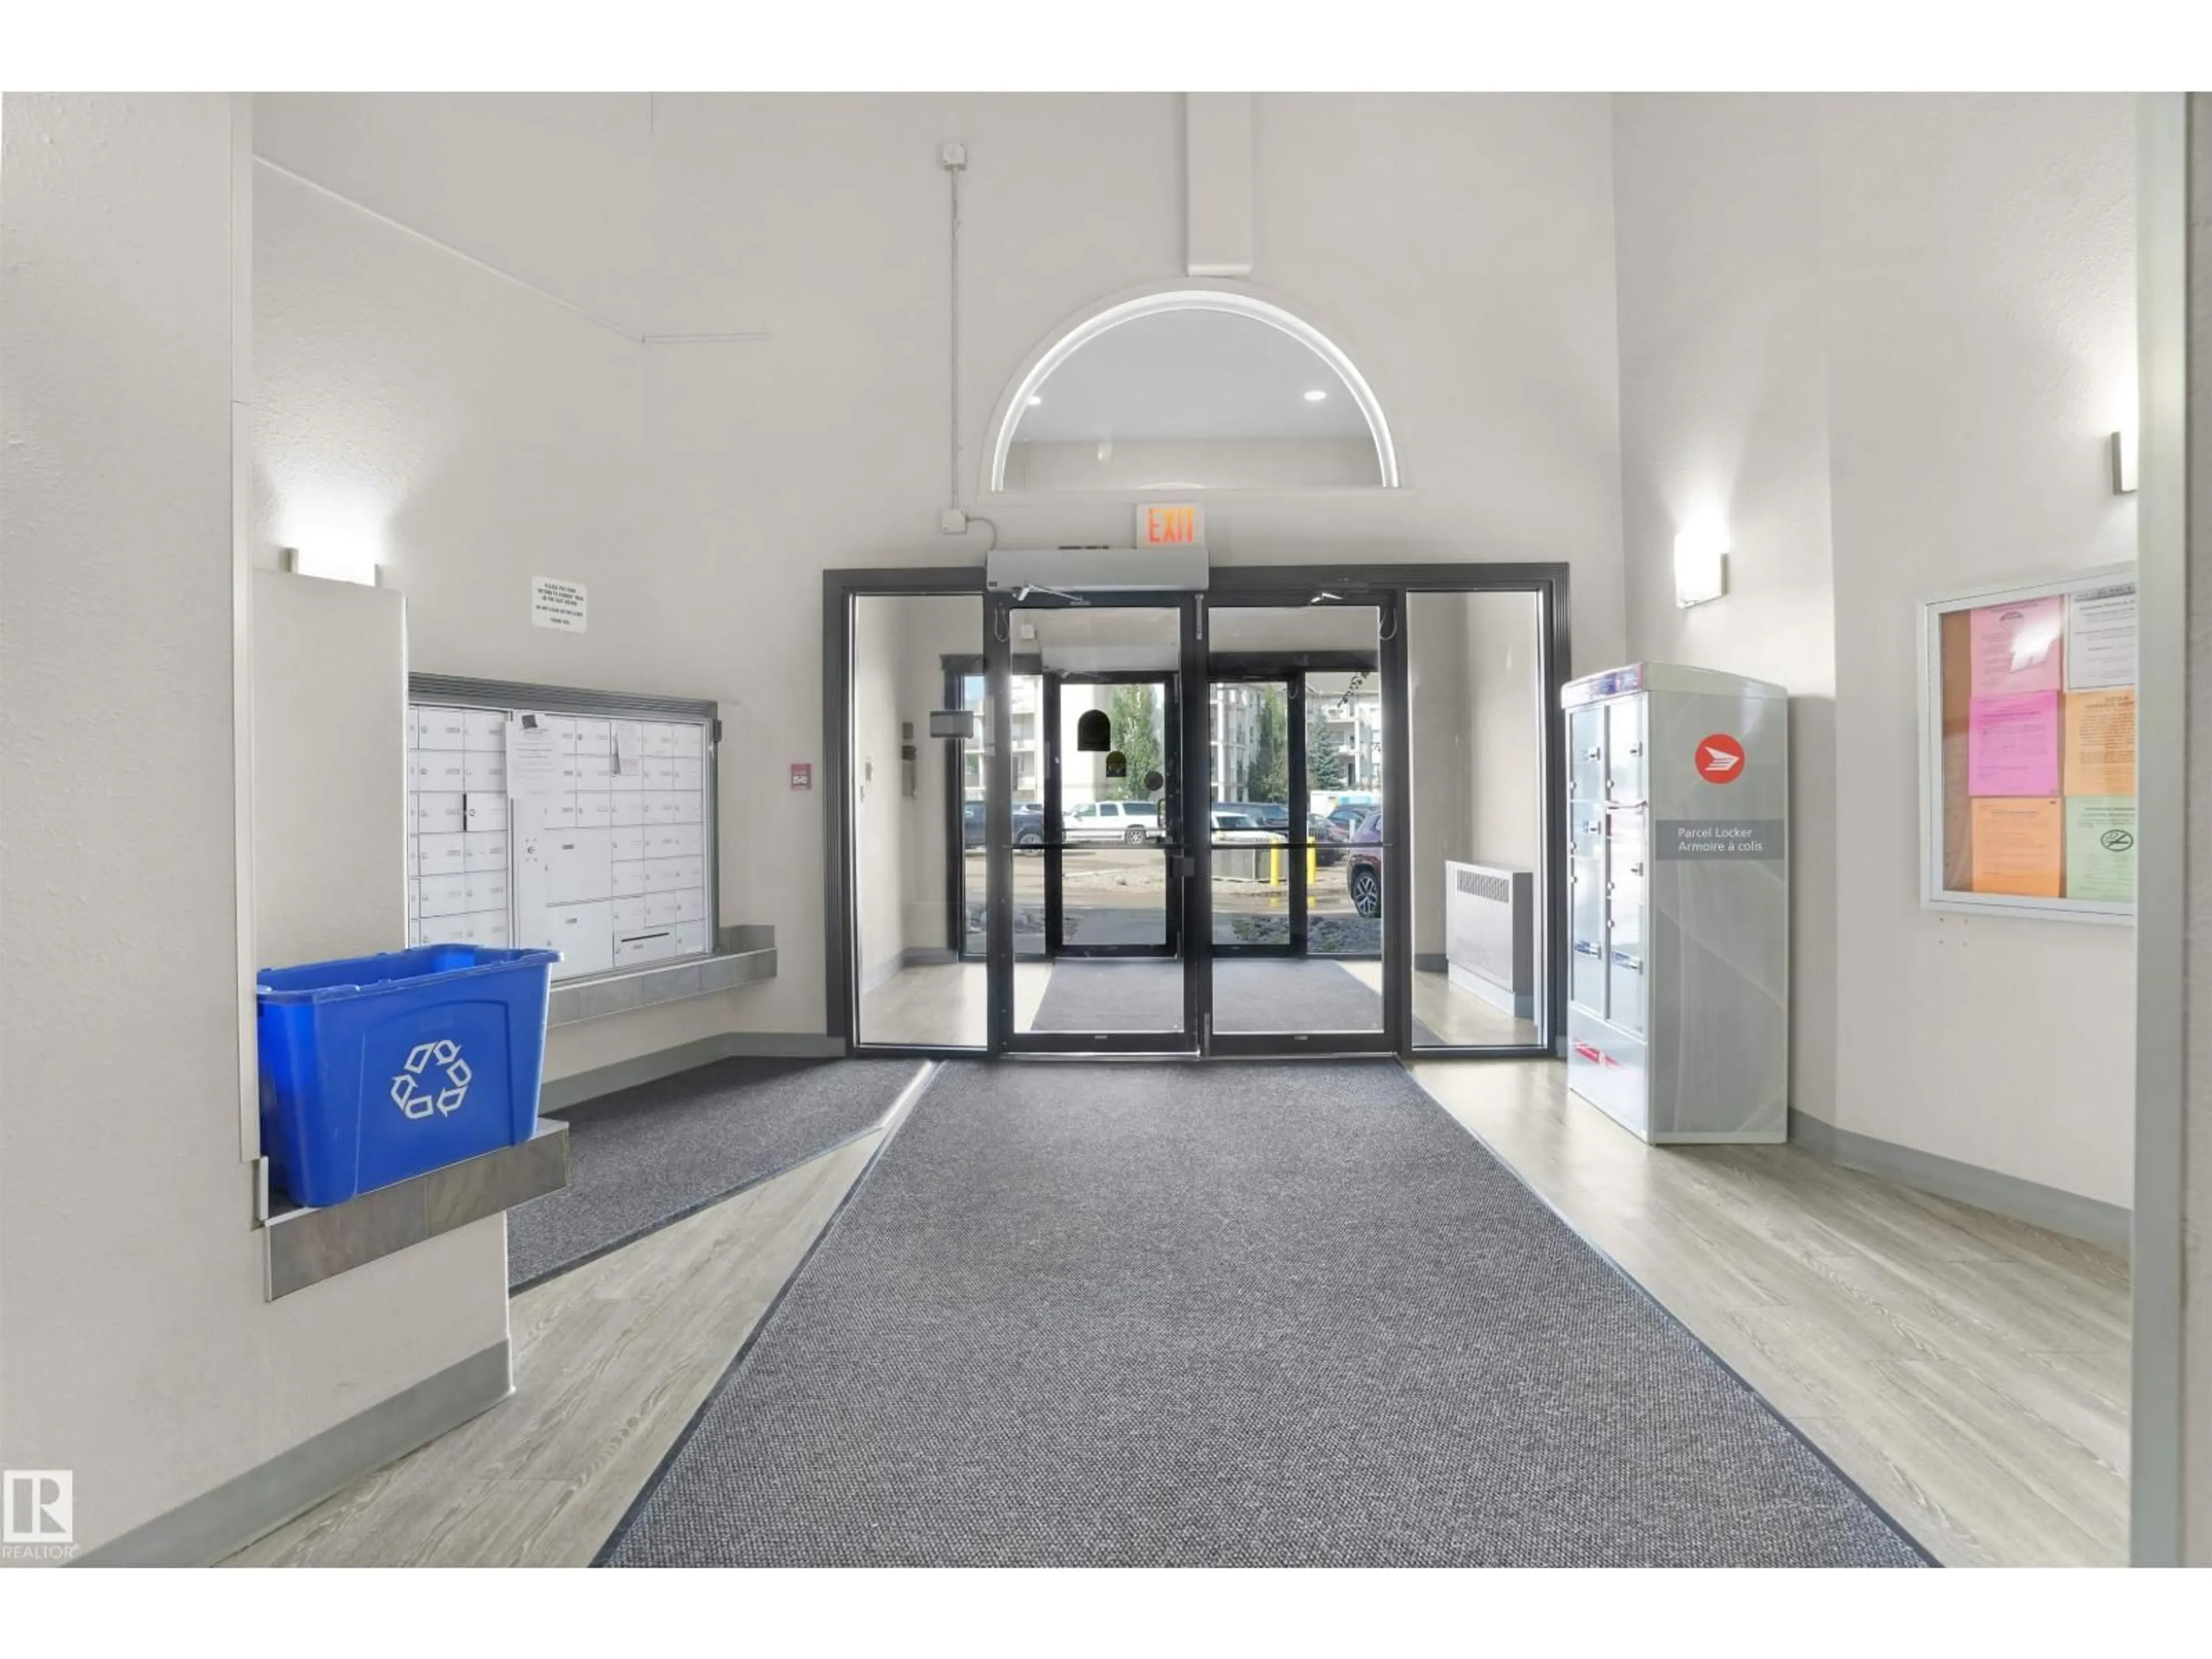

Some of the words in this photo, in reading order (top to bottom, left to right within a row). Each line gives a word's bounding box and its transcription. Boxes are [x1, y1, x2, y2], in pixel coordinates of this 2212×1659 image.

[1149, 507, 1195, 543] EXIT
[1677, 827, 1712, 838] Parcel
[1715, 827, 1753, 838] Locker
[1678, 841, 1725, 851] Armoire
[1738, 840, 1763, 851] colis
